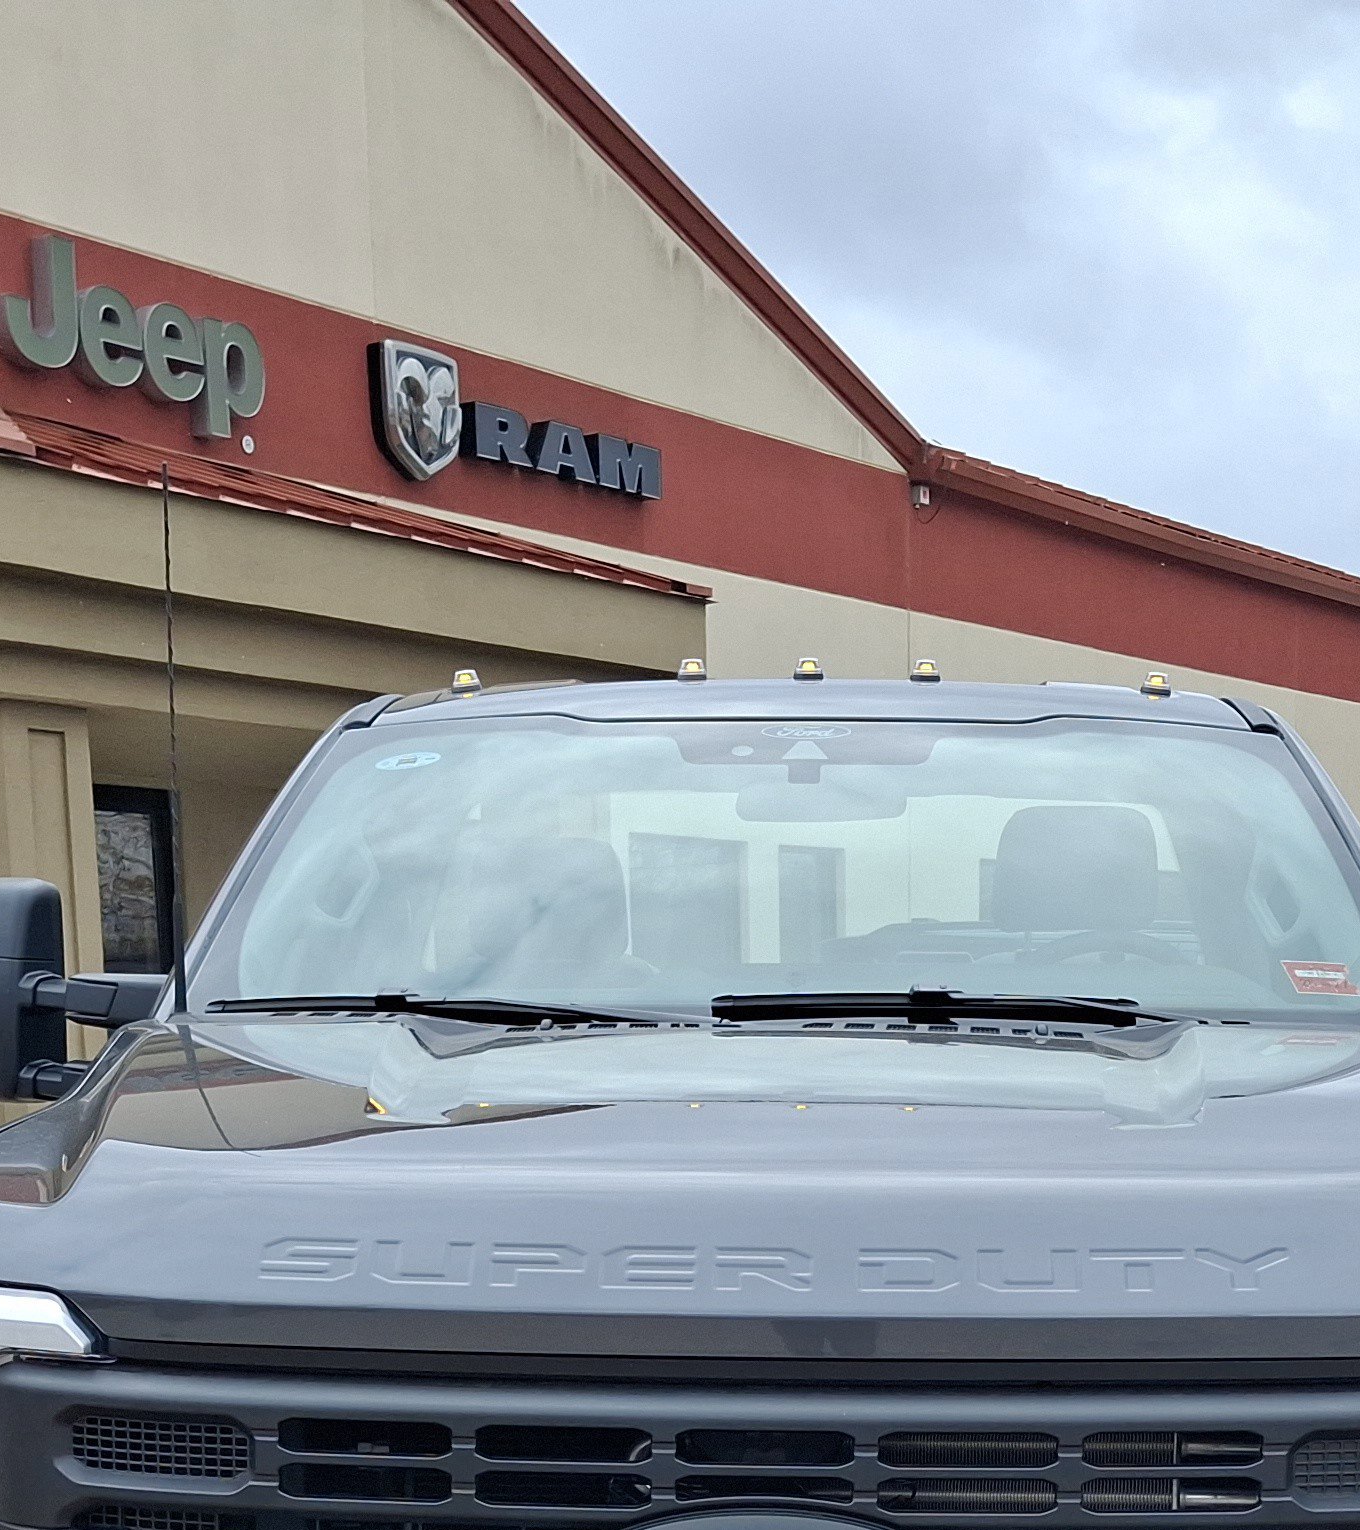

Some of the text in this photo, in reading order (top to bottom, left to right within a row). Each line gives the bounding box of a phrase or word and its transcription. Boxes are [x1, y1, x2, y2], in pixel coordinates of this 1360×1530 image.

[462, 401, 661, 499] RAM
[776, 726, 835, 737] Ford
[258, 1236, 1290, 1293] SUPER DUTY
